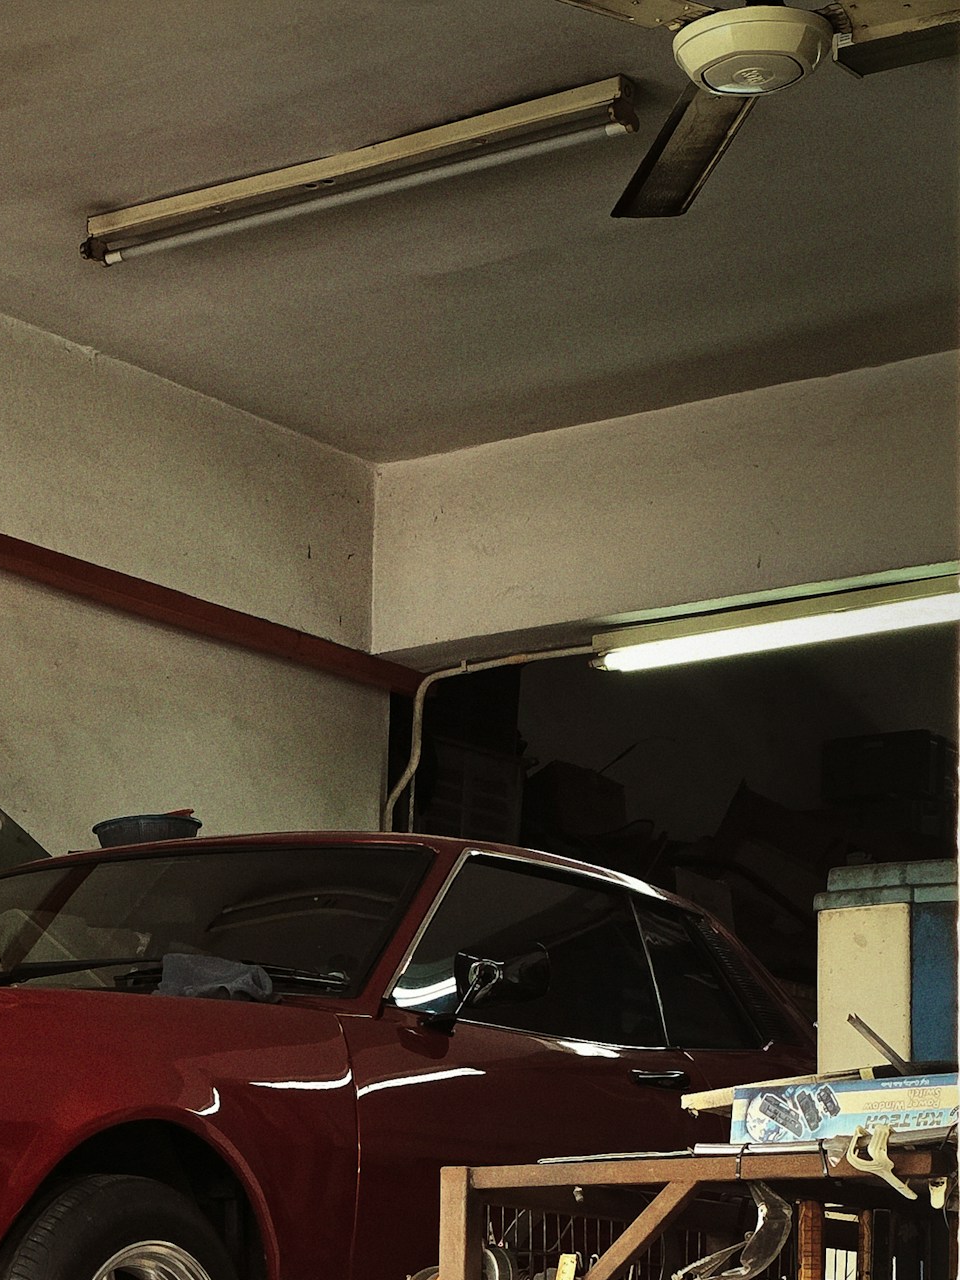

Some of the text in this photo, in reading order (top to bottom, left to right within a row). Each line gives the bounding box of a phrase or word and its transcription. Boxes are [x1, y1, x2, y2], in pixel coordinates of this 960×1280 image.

[908, 1088, 941, 1099] Switch
[863, 1098, 940, 1112] Power Window
[865, 1111, 943, 1129] KH-TECH
